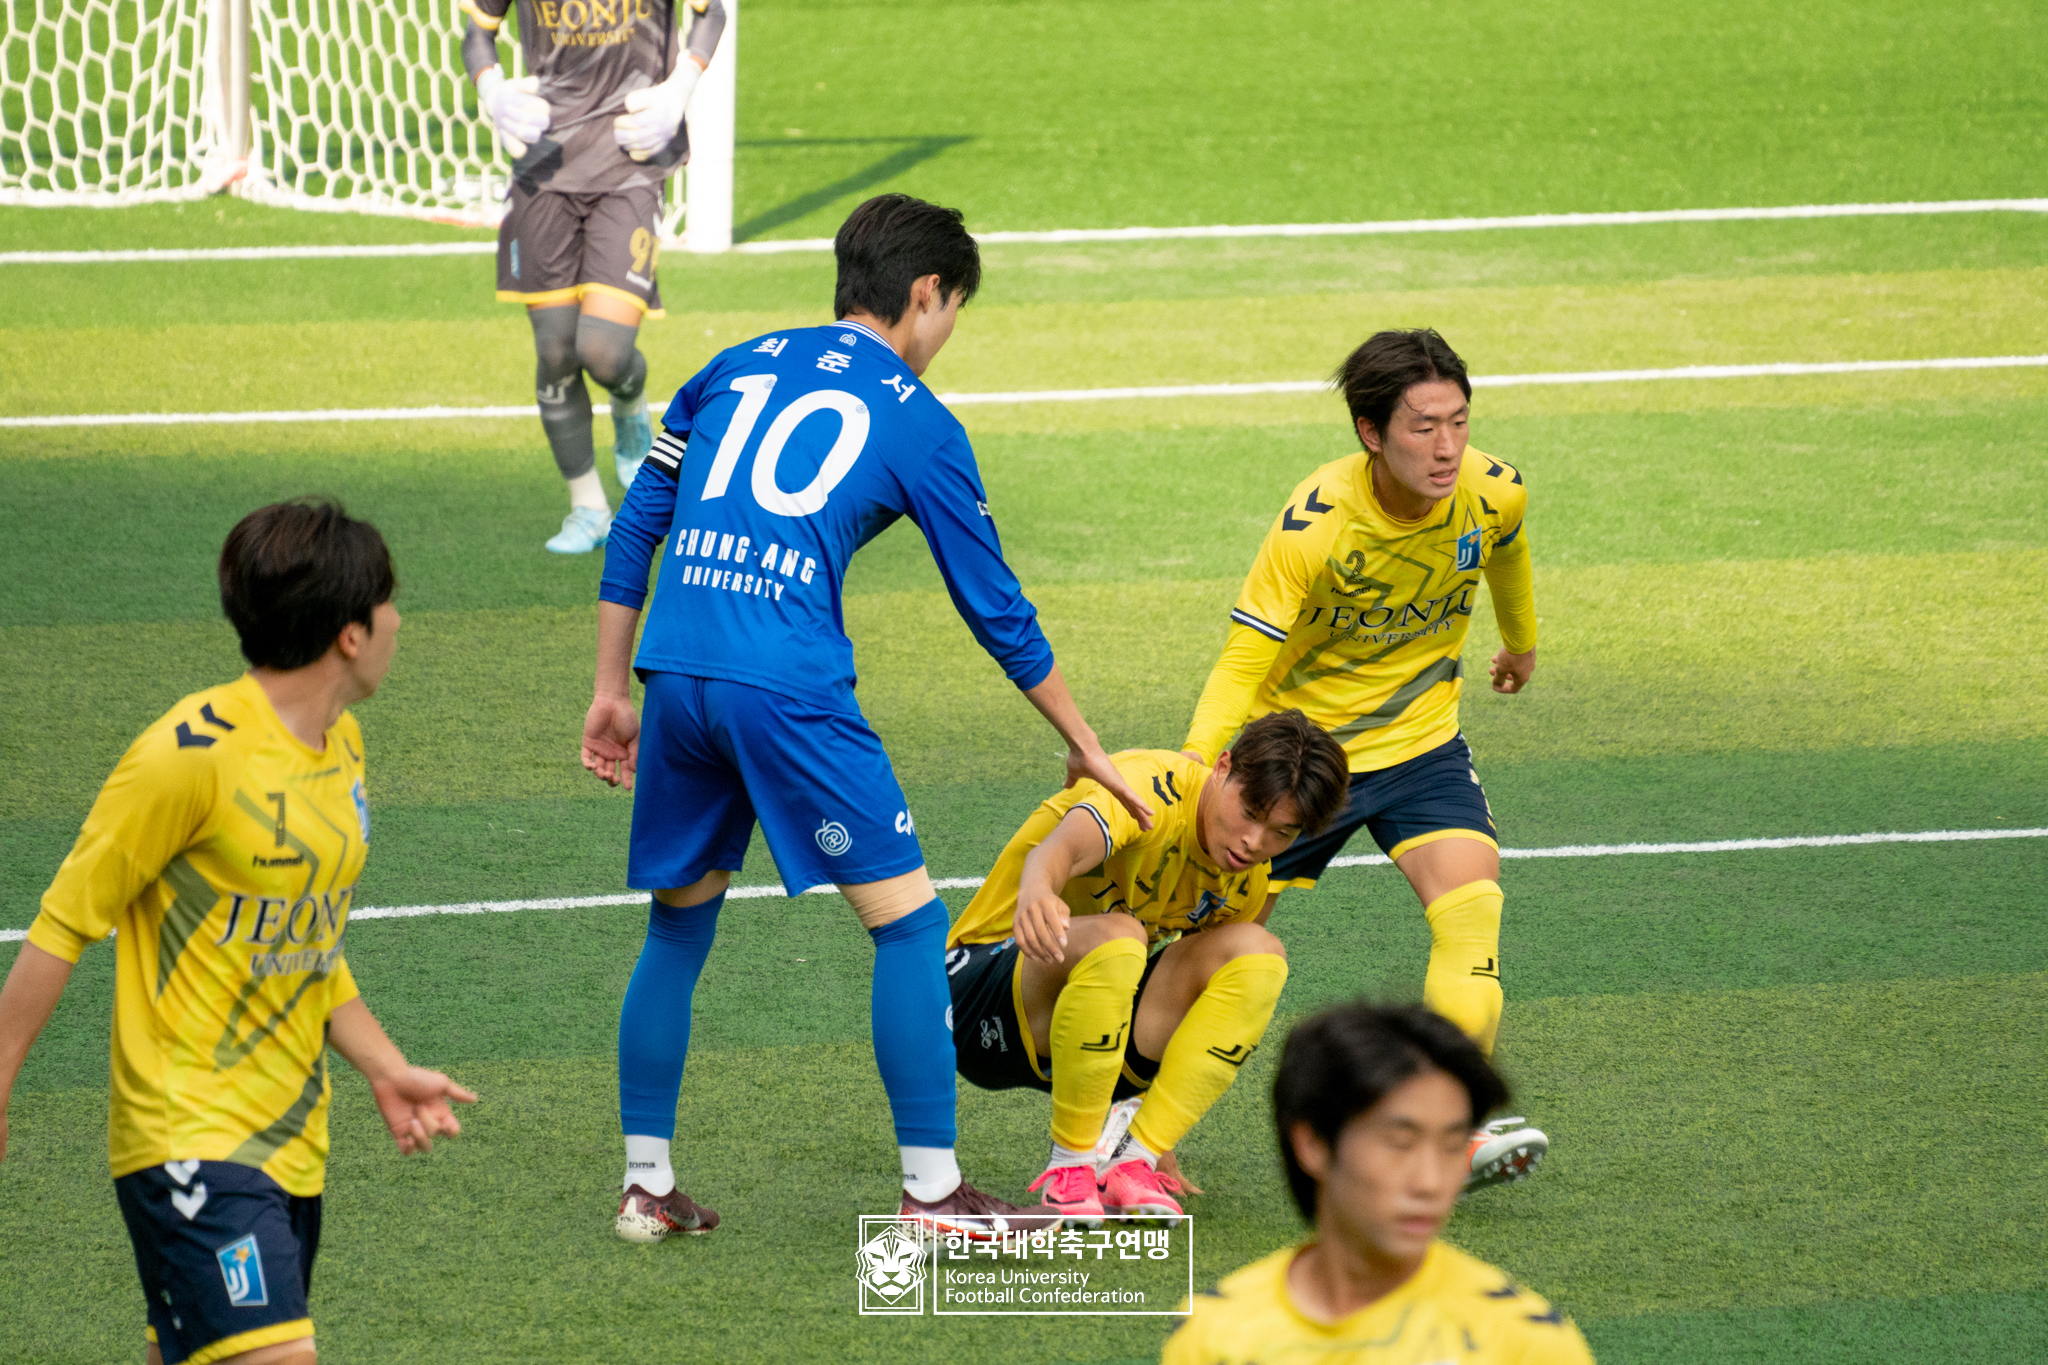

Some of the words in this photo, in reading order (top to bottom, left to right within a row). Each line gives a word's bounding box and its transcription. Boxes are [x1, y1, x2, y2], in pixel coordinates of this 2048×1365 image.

[701, 373, 871, 517] 10
[682, 565, 784, 601] UNIVERSITY
[1345, 550, 1366, 588] 2
[1303, 587, 1474, 630] JEONJU
